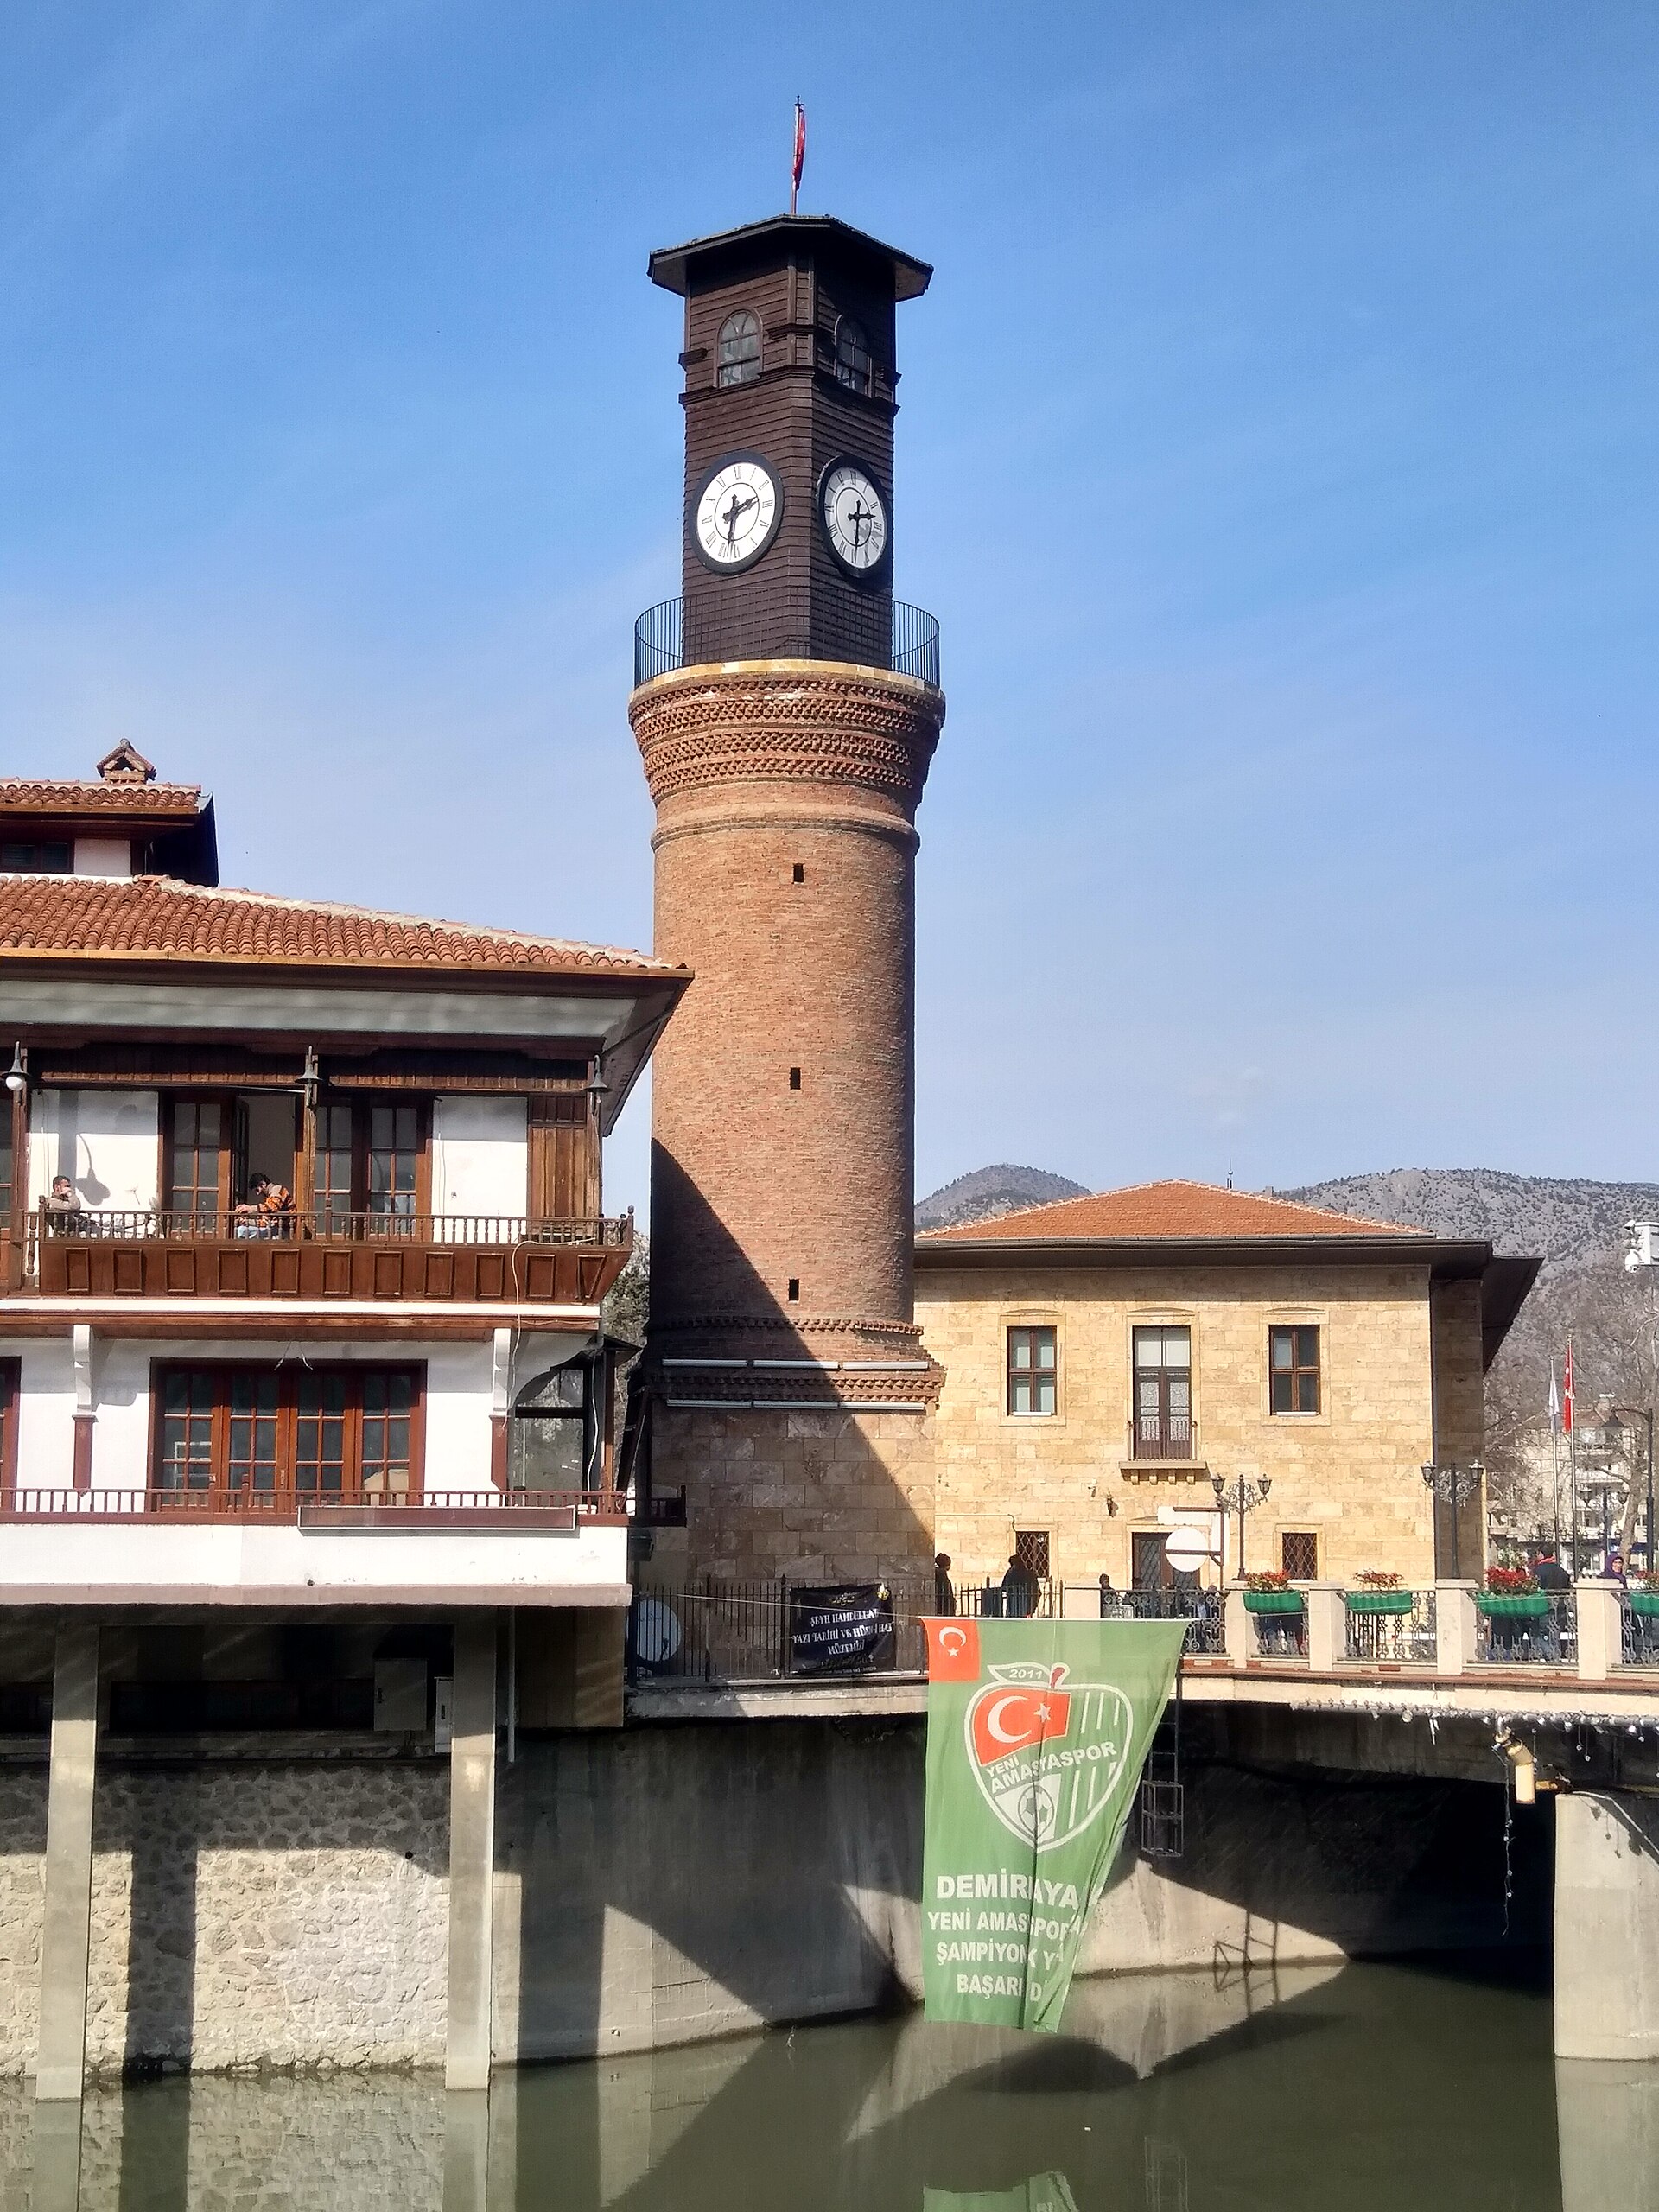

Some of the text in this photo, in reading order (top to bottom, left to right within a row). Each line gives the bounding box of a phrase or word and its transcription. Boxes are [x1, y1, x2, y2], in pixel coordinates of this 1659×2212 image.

[1009, 1669, 1043, 1679] 2011
[986, 1754, 1020, 1777] YENİ
[927, 1907, 971, 1931] YENİ
